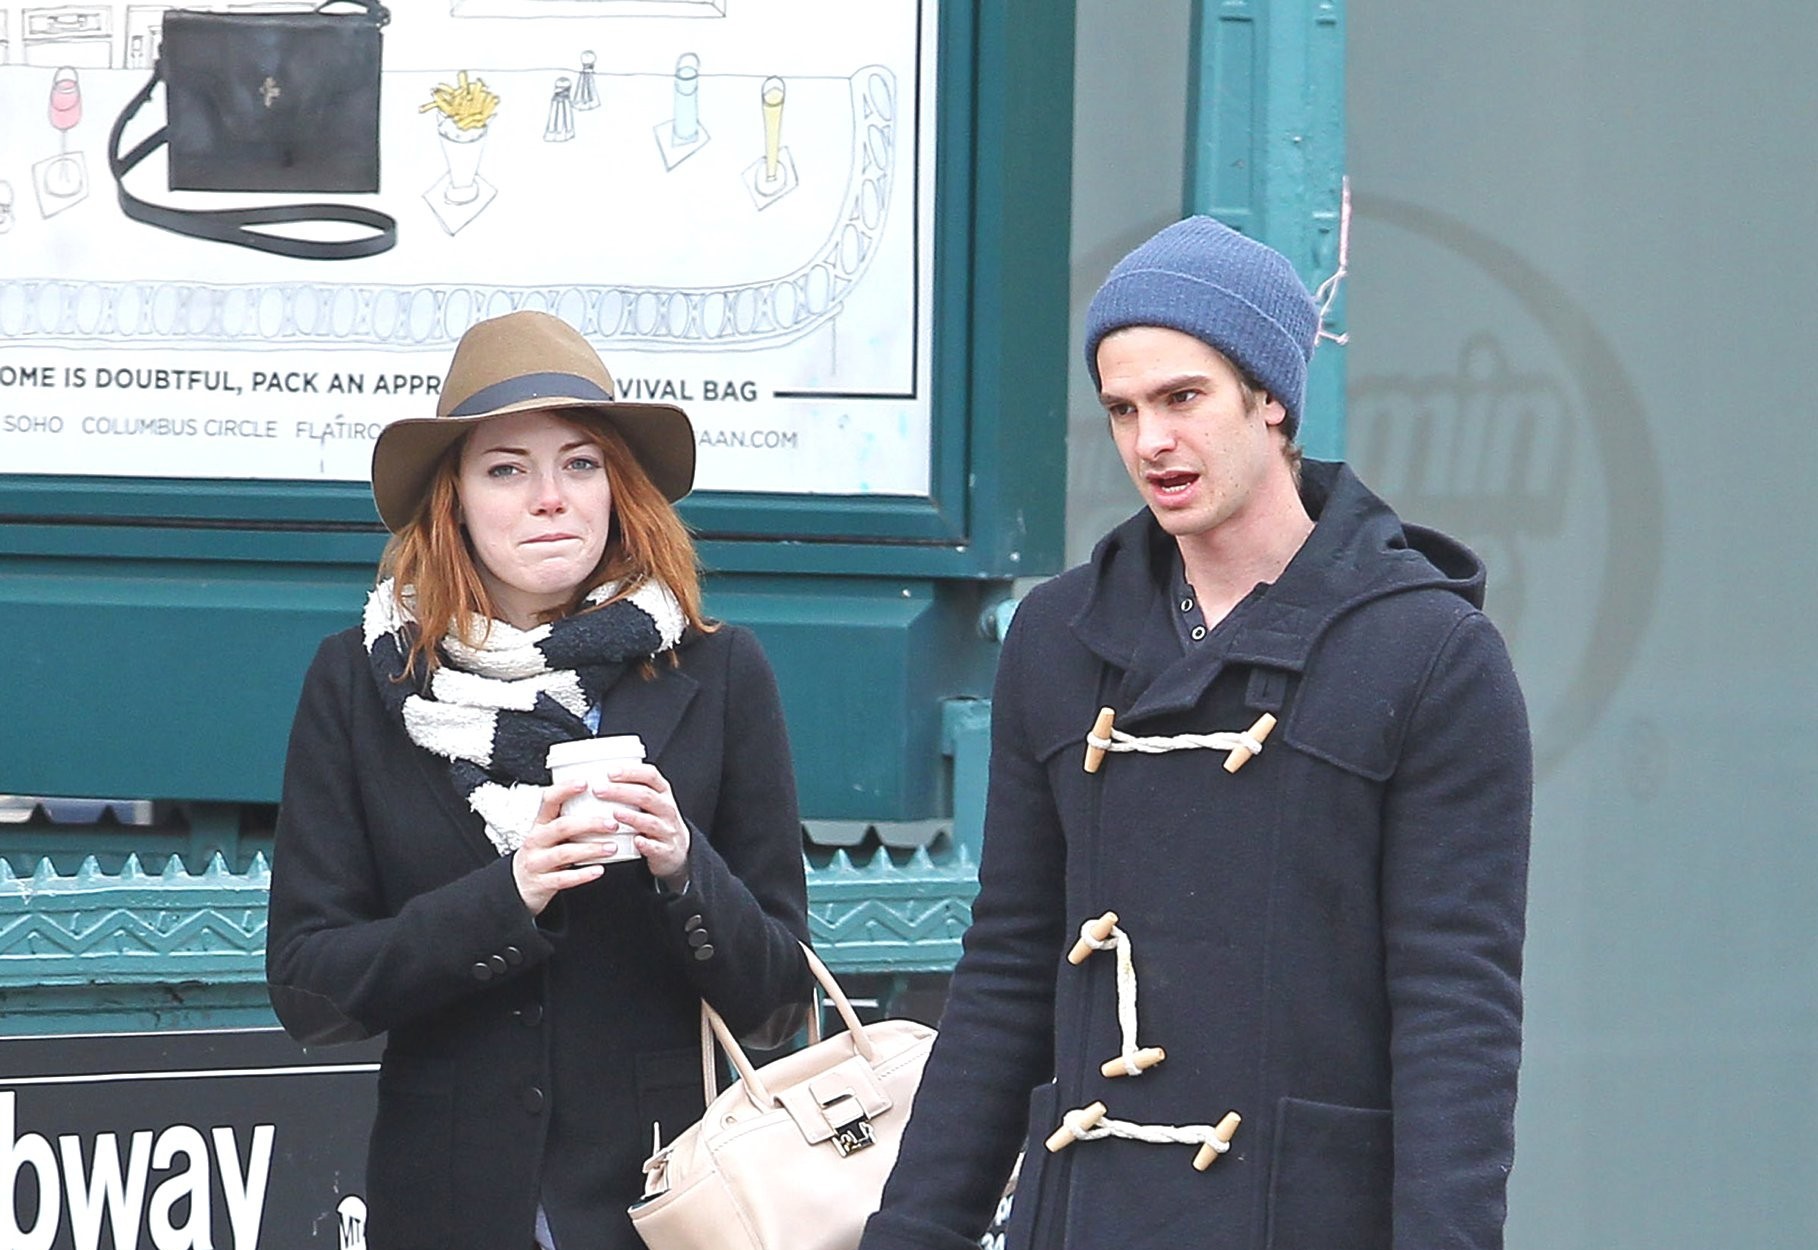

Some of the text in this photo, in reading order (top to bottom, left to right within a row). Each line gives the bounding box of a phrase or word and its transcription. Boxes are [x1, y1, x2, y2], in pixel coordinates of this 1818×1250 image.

[64, 367, 87, 389] IS
[96, 368, 242, 395] DOUBTFUL,
[252, 373, 319, 393] PACK
[327, 374, 364, 394] AN
[373, 374, 441, 396] APPR
[616, 378, 694, 400] VIVAL
[703, 380, 758, 402] BAG
[3, 415, 64, 434] SOHO
[82, 416, 197, 437] COLUMBUS
[205, 419, 278, 438] CIRCLE
[696, 430, 799, 449] AAN.COM
